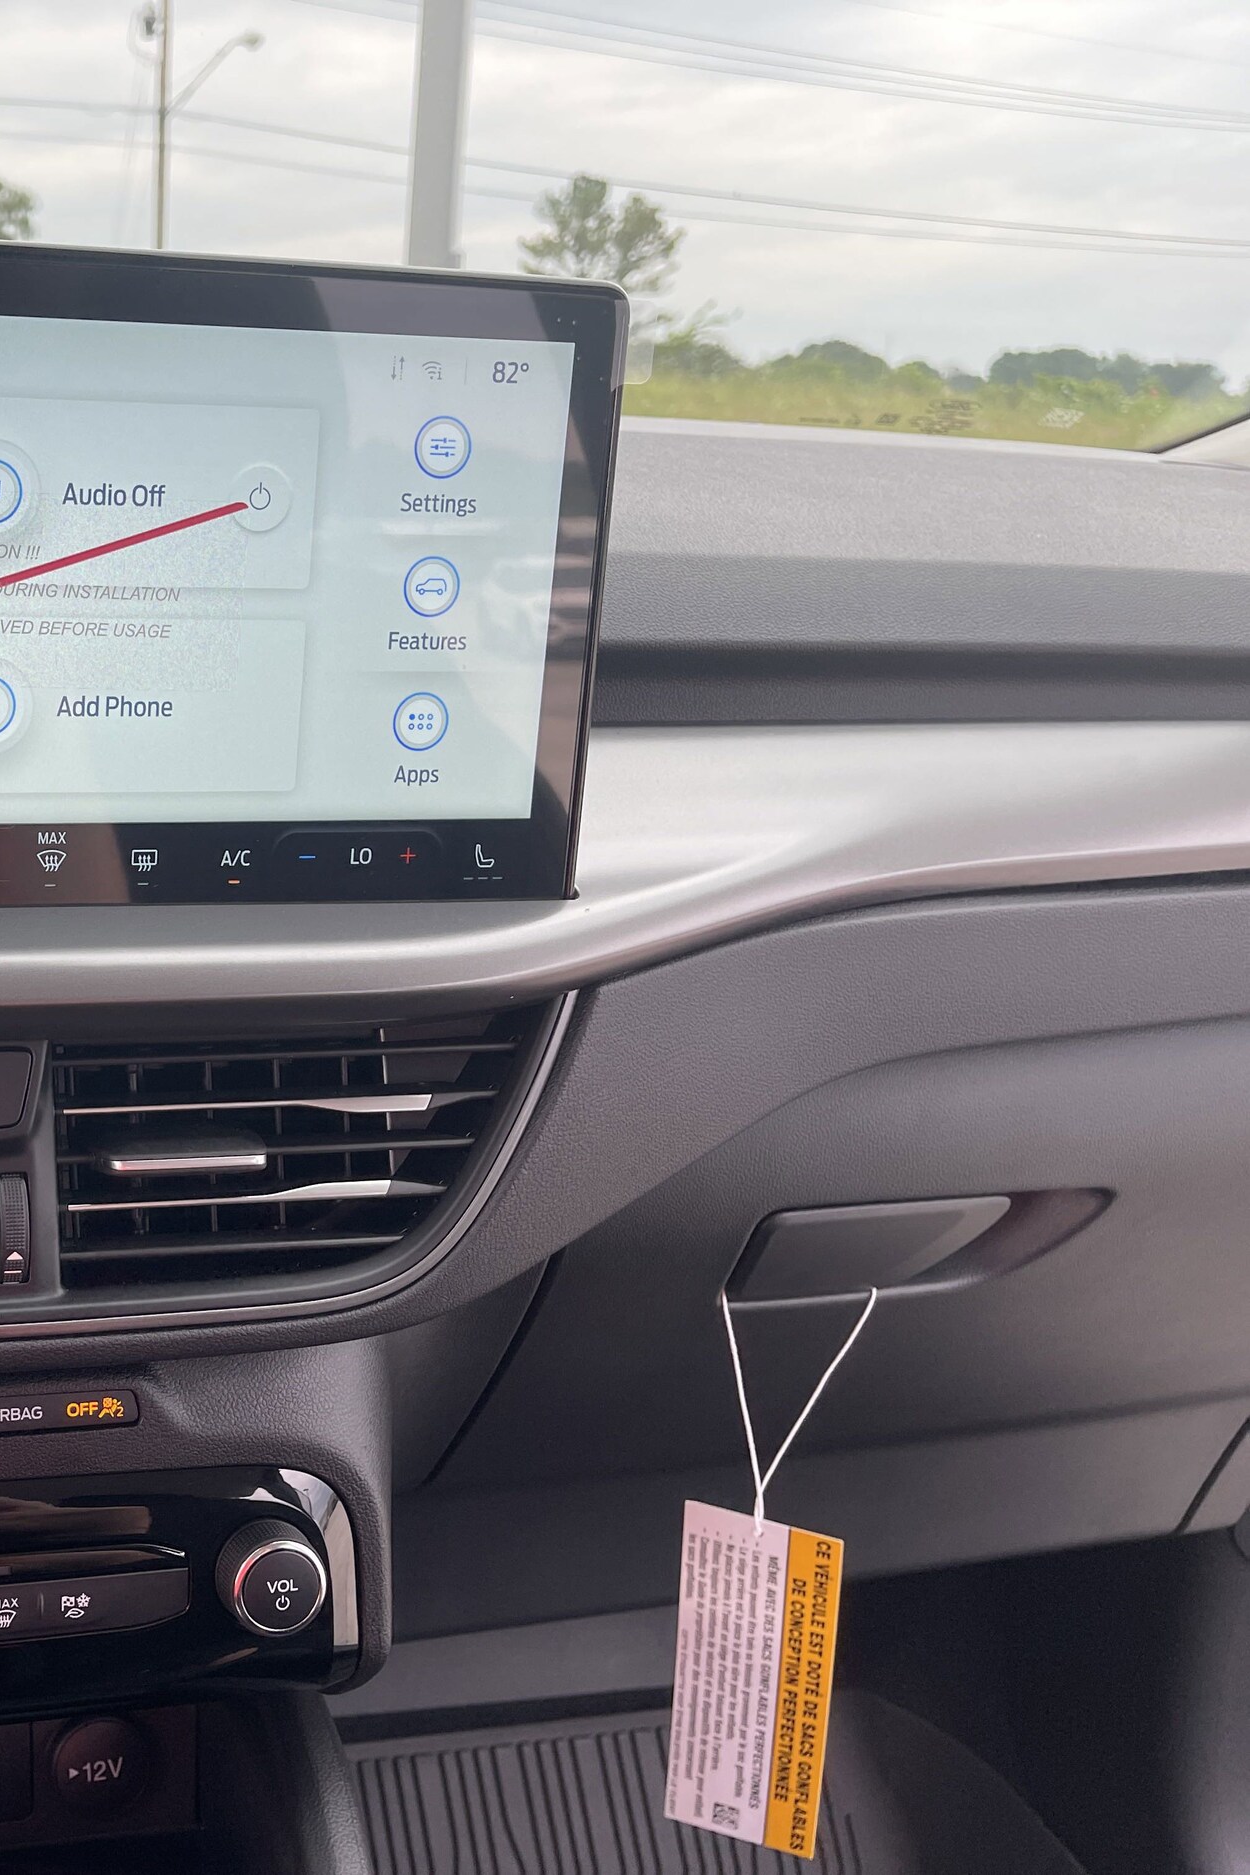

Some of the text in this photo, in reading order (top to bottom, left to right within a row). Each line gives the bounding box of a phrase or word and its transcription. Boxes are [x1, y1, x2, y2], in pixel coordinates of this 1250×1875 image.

[62, 482, 165, 508] Audio Off
[400, 493, 477, 517] Settings
[62, 583, 181, 603] INSTALLATION
[39, 619, 109, 637] BEFORE
[113, 621, 172, 639] USAGE
[388, 631, 467, 651] Features
[56, 695, 173, 719] Add Phone
[394, 765, 439, 786] Apps
[37, 831, 66, 845] MAX
[220, 849, 251, 867] A/C
[350, 848, 372, 865] LO
[66, 1401, 98, 1418] OFF
[266, 1579, 299, 1594] VOL
[791, 1577, 807, 1597] DE
[782, 1599, 805, 1687] CONCEPTION
[789, 1539, 834, 1852] CE VÉHICULE EST DOTÉ DE SACS GONFLABLES
[81, 1758, 124, 1782] 12V
